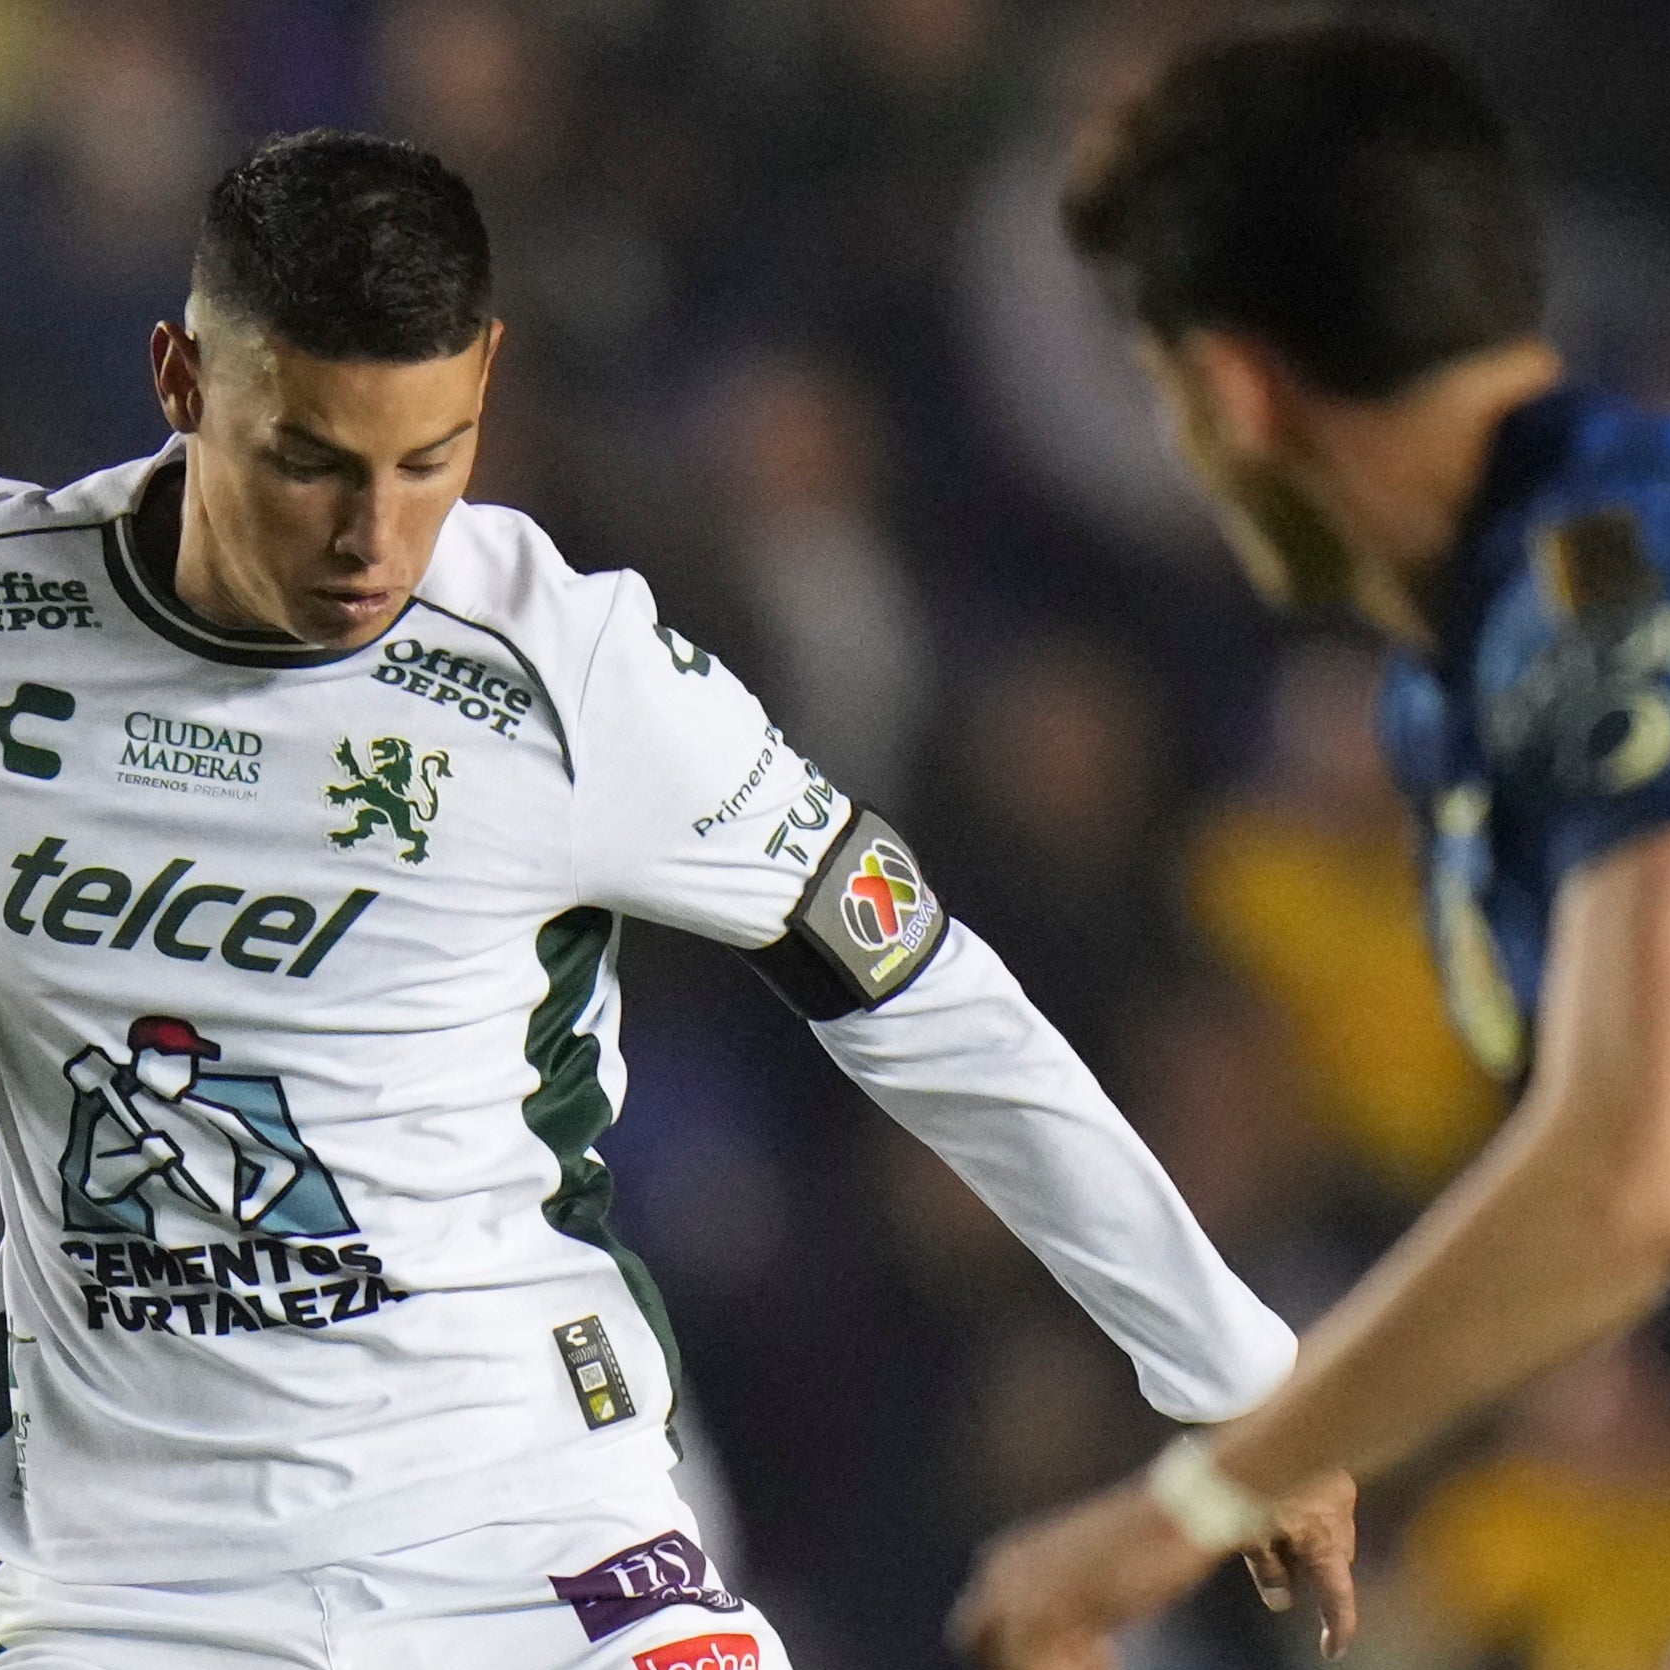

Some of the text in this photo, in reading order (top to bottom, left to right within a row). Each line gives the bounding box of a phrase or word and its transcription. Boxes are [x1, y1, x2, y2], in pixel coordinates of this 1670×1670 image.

[384, 639, 532, 715] Office
[115, 771, 258, 801] TERRENOS PREMIUM
[118, 739, 261, 785] MADERAS
[691, 747, 774, 838] Primera
[2, 836, 379, 978] telcel
[59, 1239, 383, 1290] CEMENTOS
